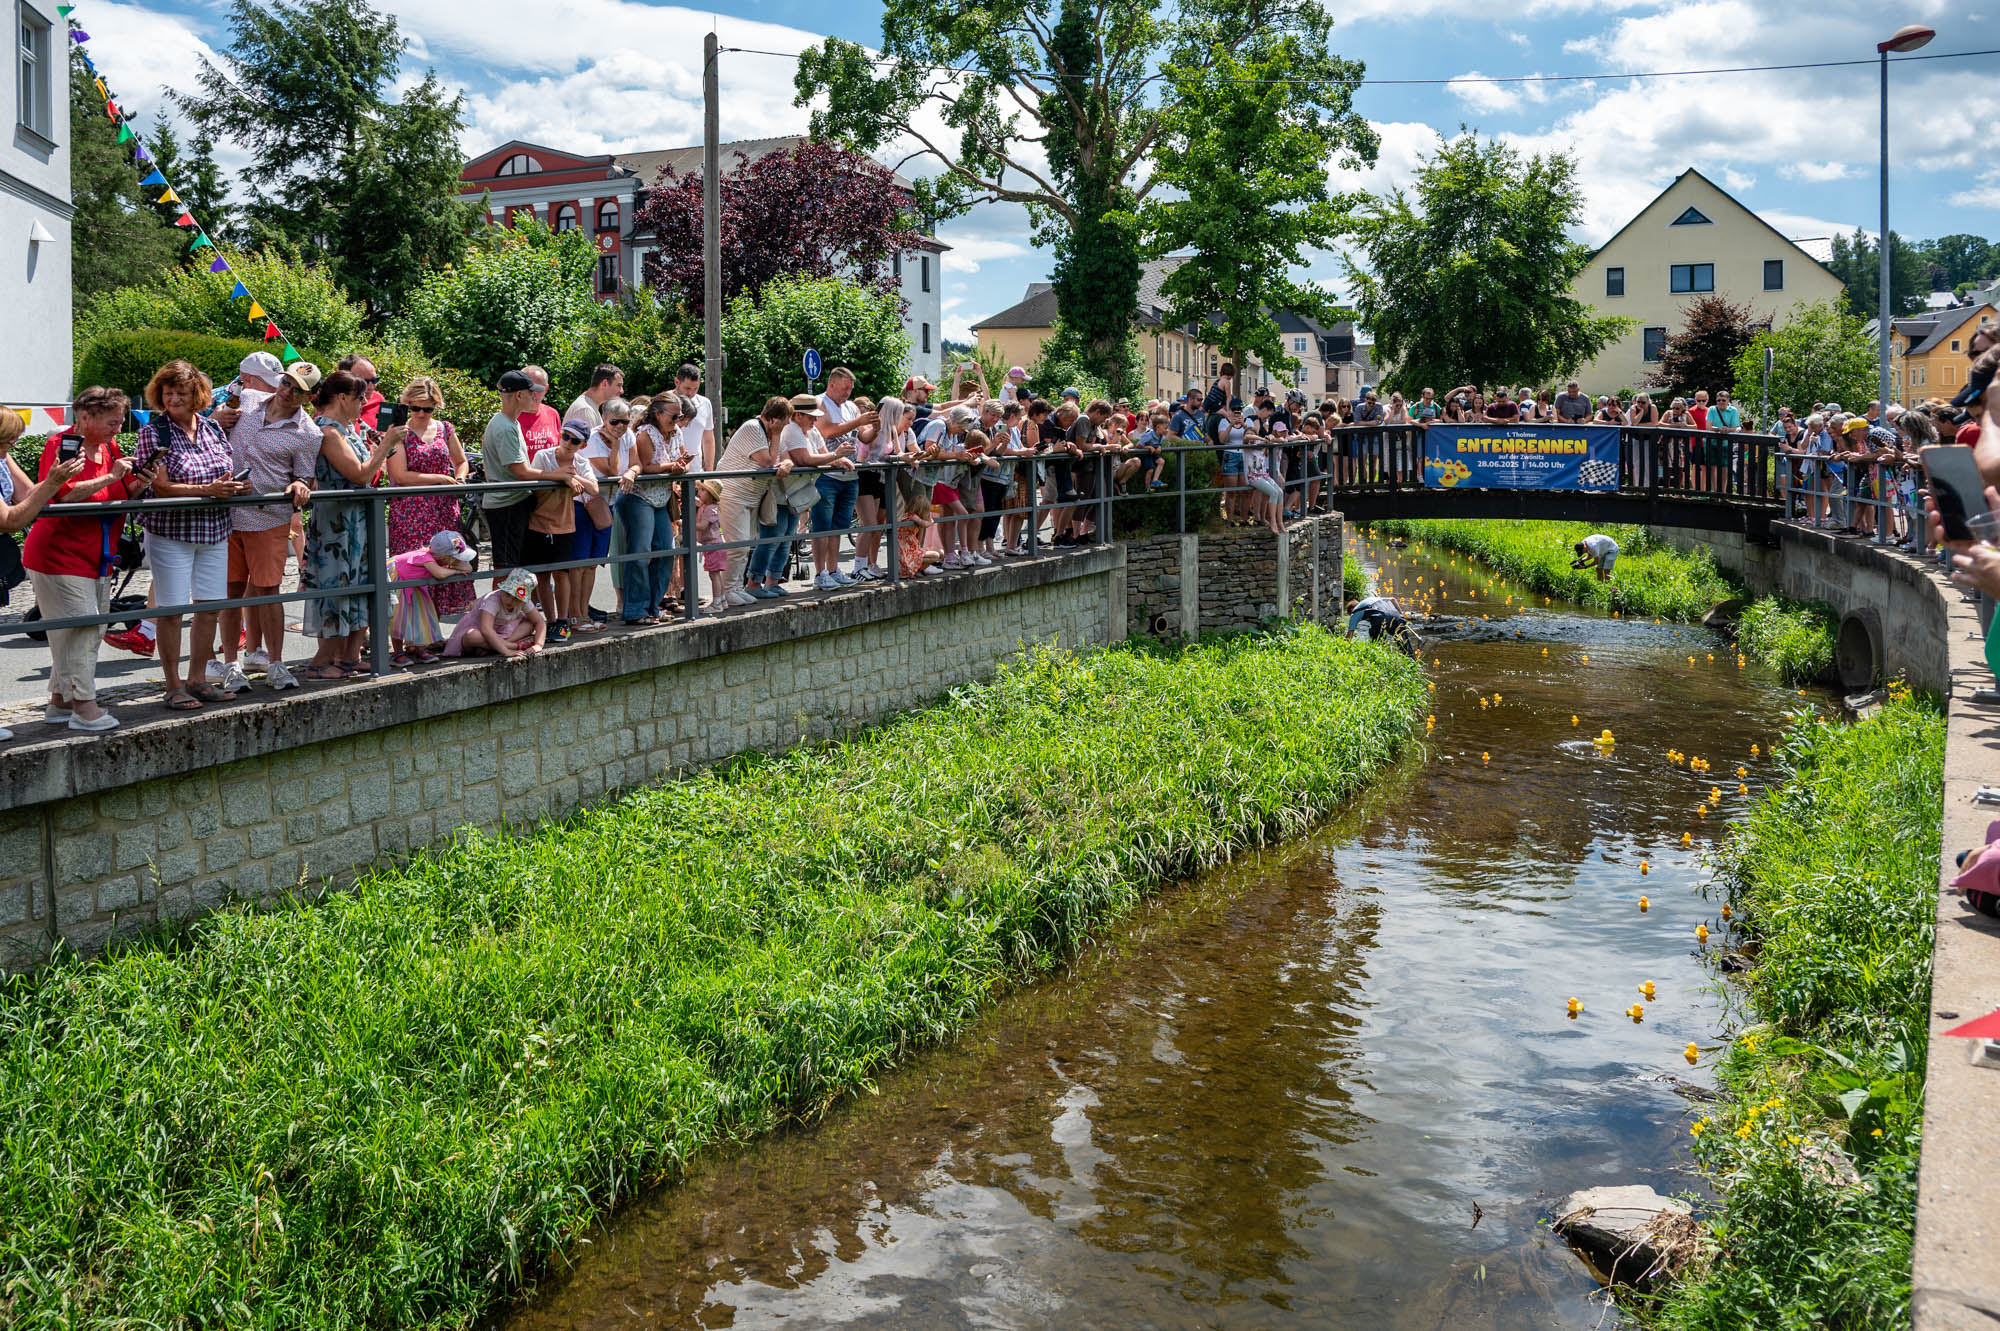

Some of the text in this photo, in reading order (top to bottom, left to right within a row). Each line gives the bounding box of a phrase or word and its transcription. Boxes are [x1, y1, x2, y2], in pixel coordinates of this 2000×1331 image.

[1456, 438, 1587, 454] ENTENRENNEN
[1477, 460, 1519, 468] 28.06.2025
[1551, 461, 1565, 469] Uhr
